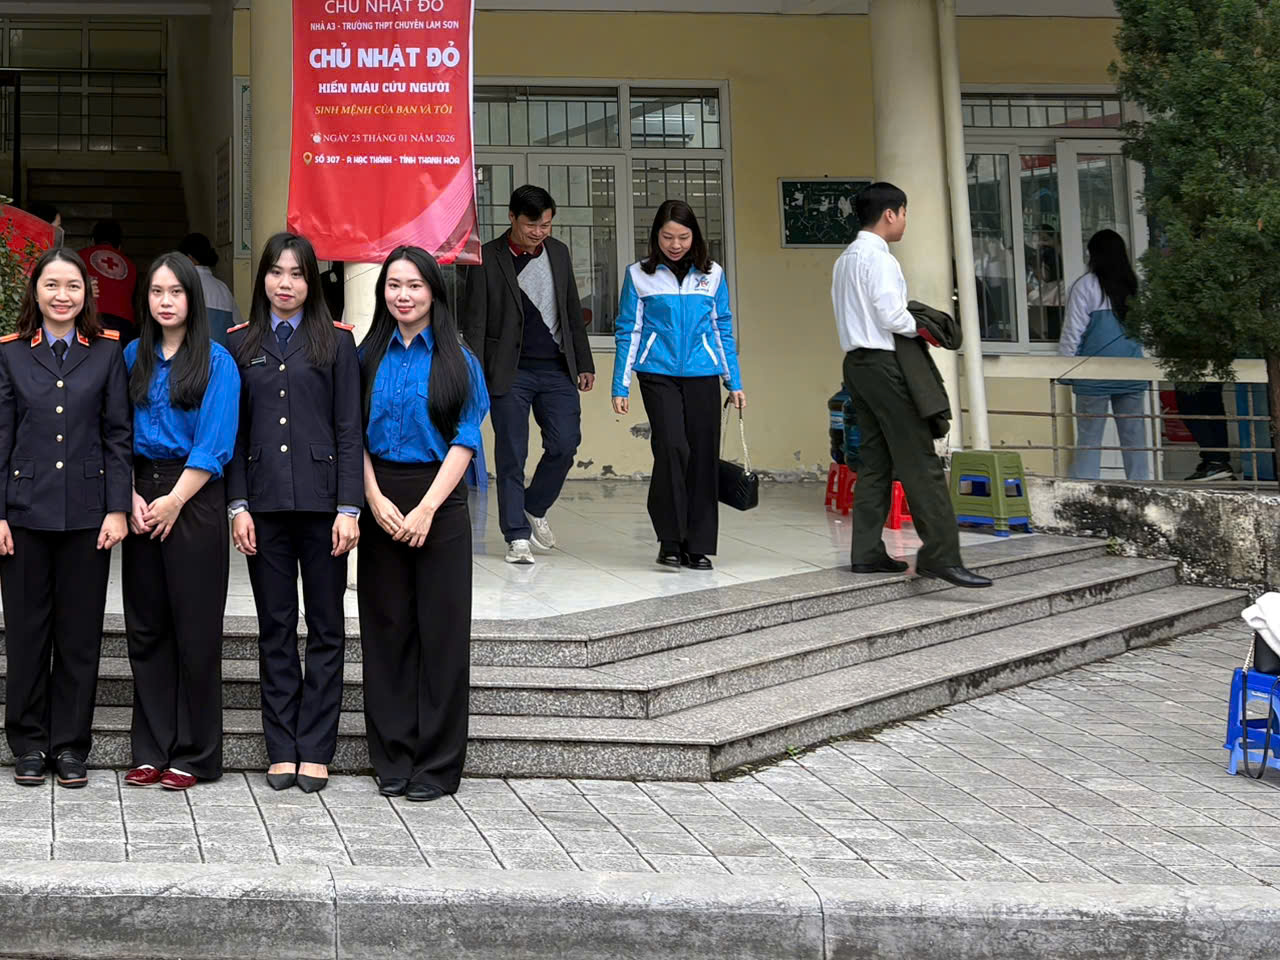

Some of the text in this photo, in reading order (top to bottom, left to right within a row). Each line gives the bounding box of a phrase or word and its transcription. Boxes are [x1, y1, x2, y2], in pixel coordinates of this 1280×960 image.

[326, 22, 336, 30] A3
[375, 21, 393, 30] THPT
[394, 19, 424, 29] CHUYÊN
[309, 41, 461, 71] CHỦ NHẬT ĐỎ
[318, 79, 347, 93] HIẾN
[315, 106, 339, 115] SINH
[341, 104, 372, 116] MỆNH
[396, 106, 417, 116] BẠN
[419, 104, 432, 114] VÀ
[434, 104, 453, 114] TÔI
[351, 134, 361, 142] 25
[398, 134, 408, 142] 01
[436, 134, 455, 143] 2026
[314, 153, 325, 163] SỐ
[418, 156, 442, 164] THANH
